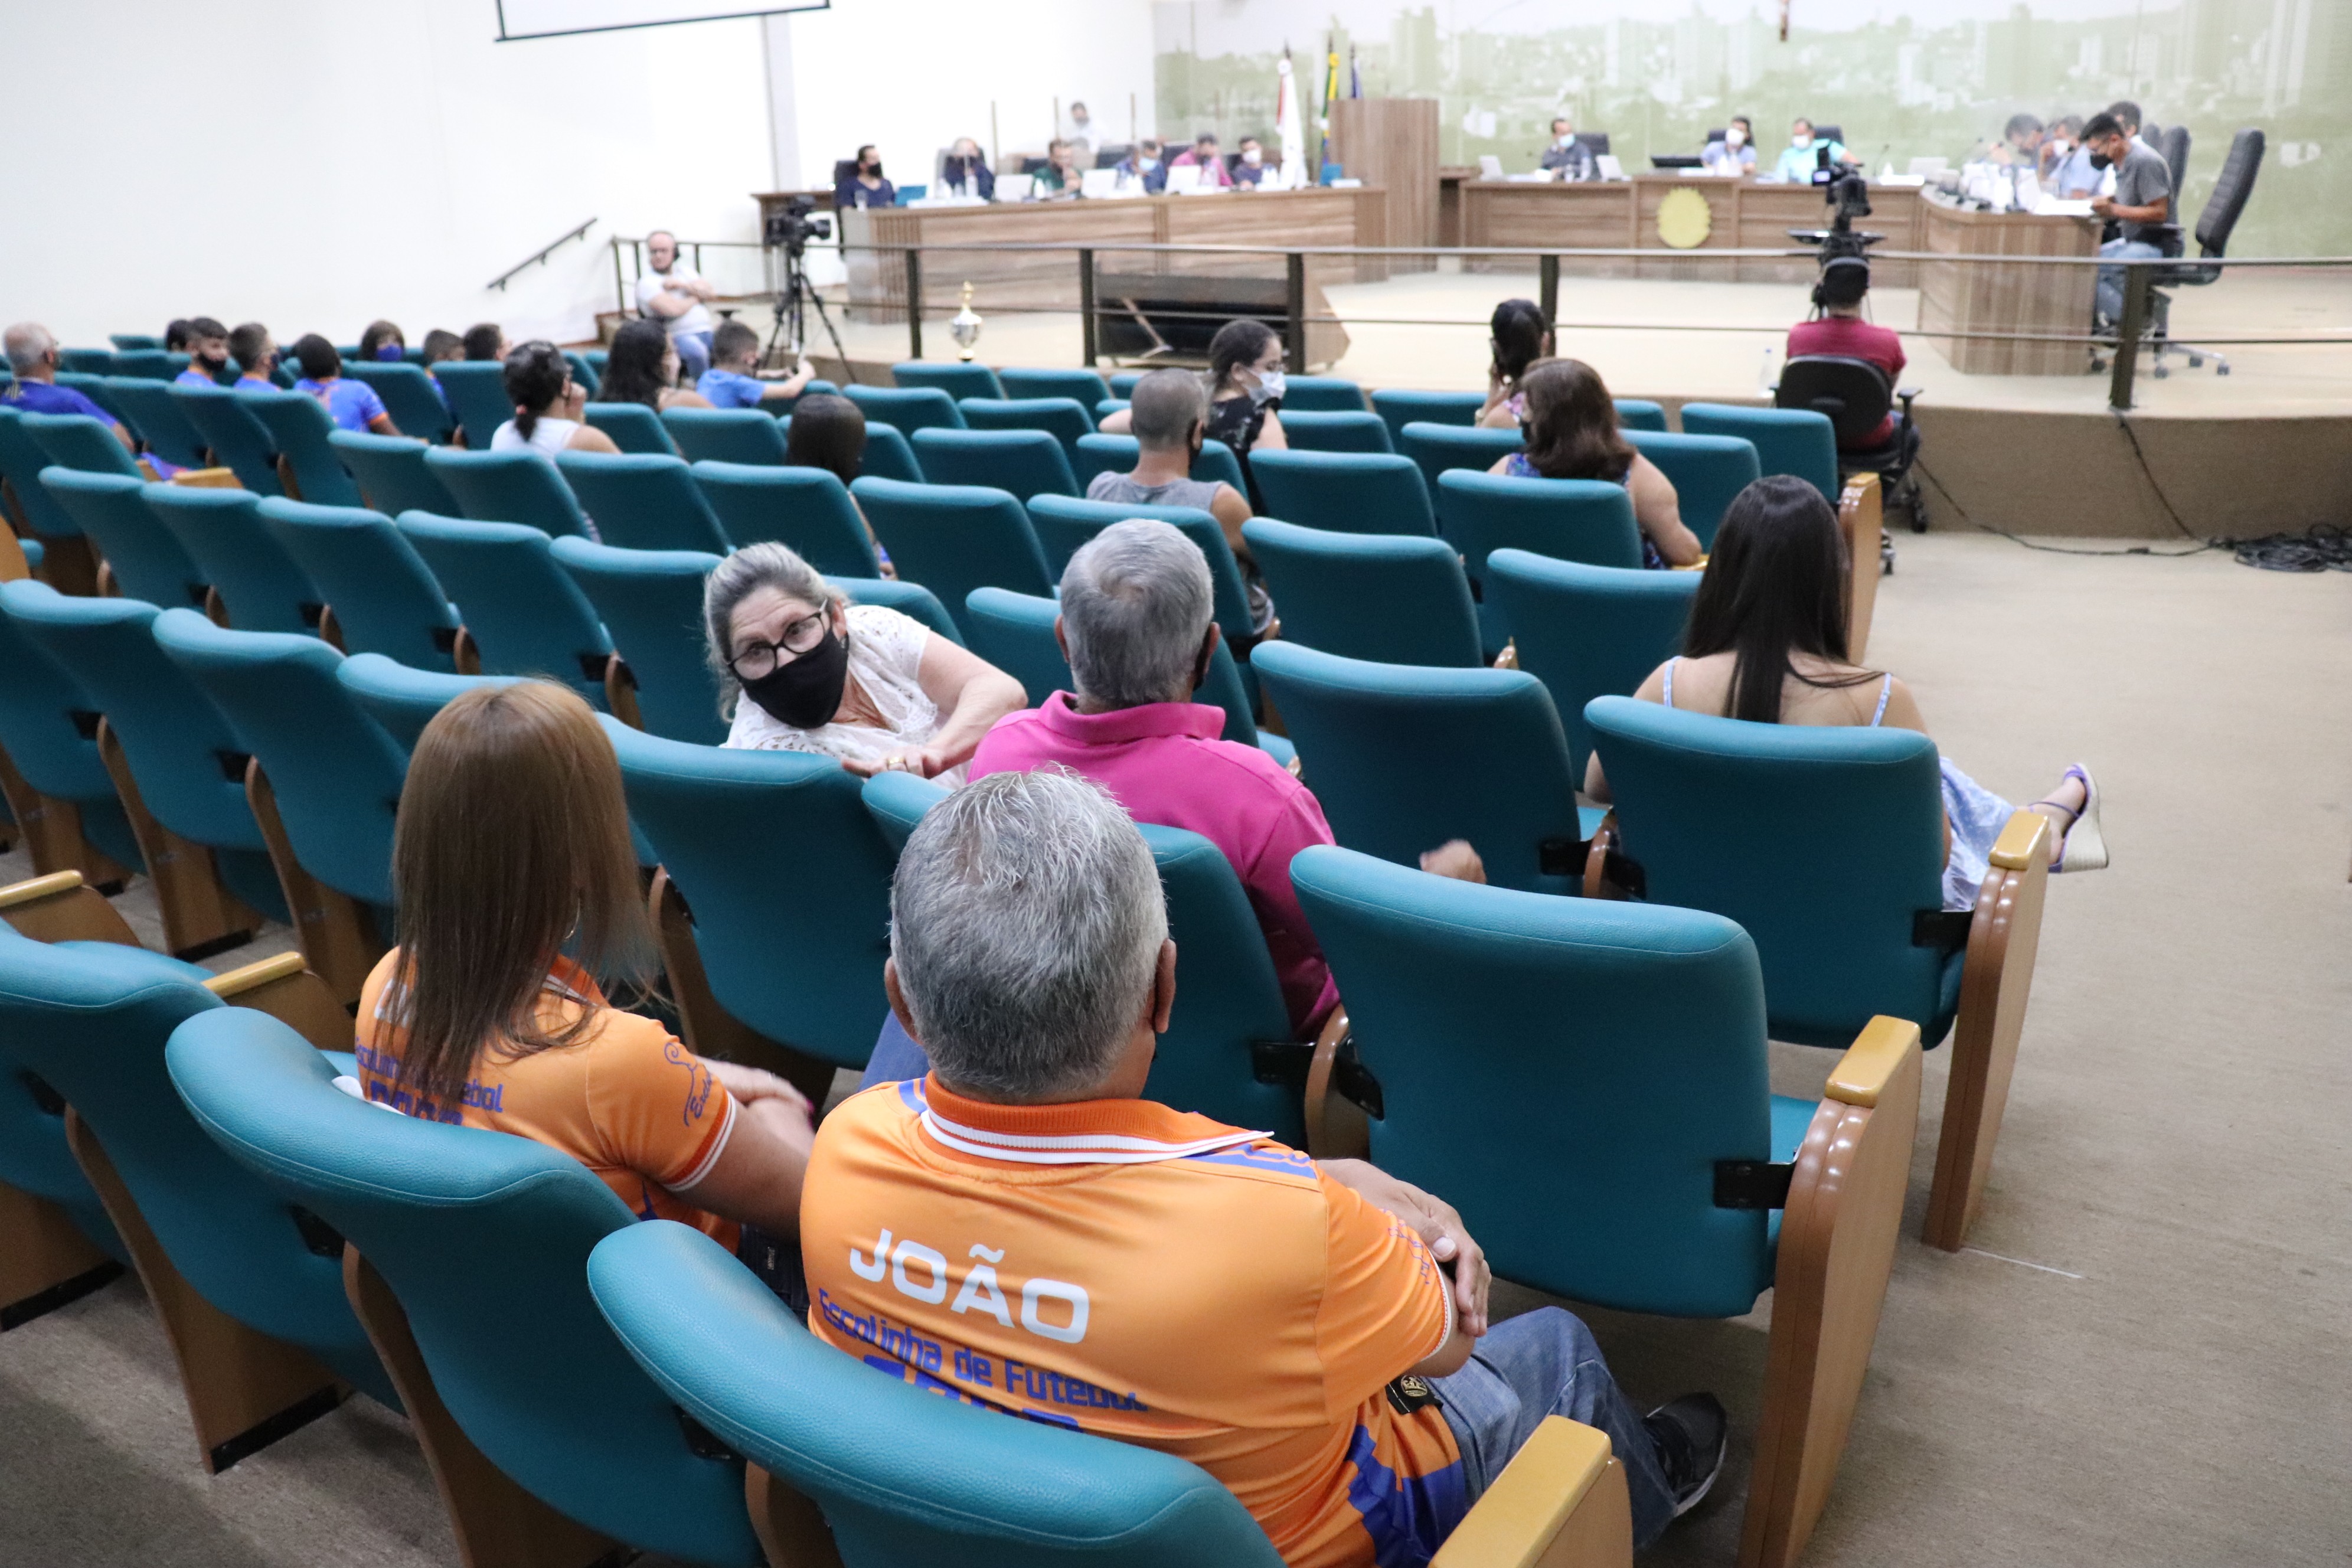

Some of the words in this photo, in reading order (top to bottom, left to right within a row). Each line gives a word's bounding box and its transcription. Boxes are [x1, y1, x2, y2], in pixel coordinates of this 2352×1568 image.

[819, 1288, 942, 1372] Escolinha
[955, 1347, 993, 1387] de
[850, 1228, 1089, 1344] JOÃO
